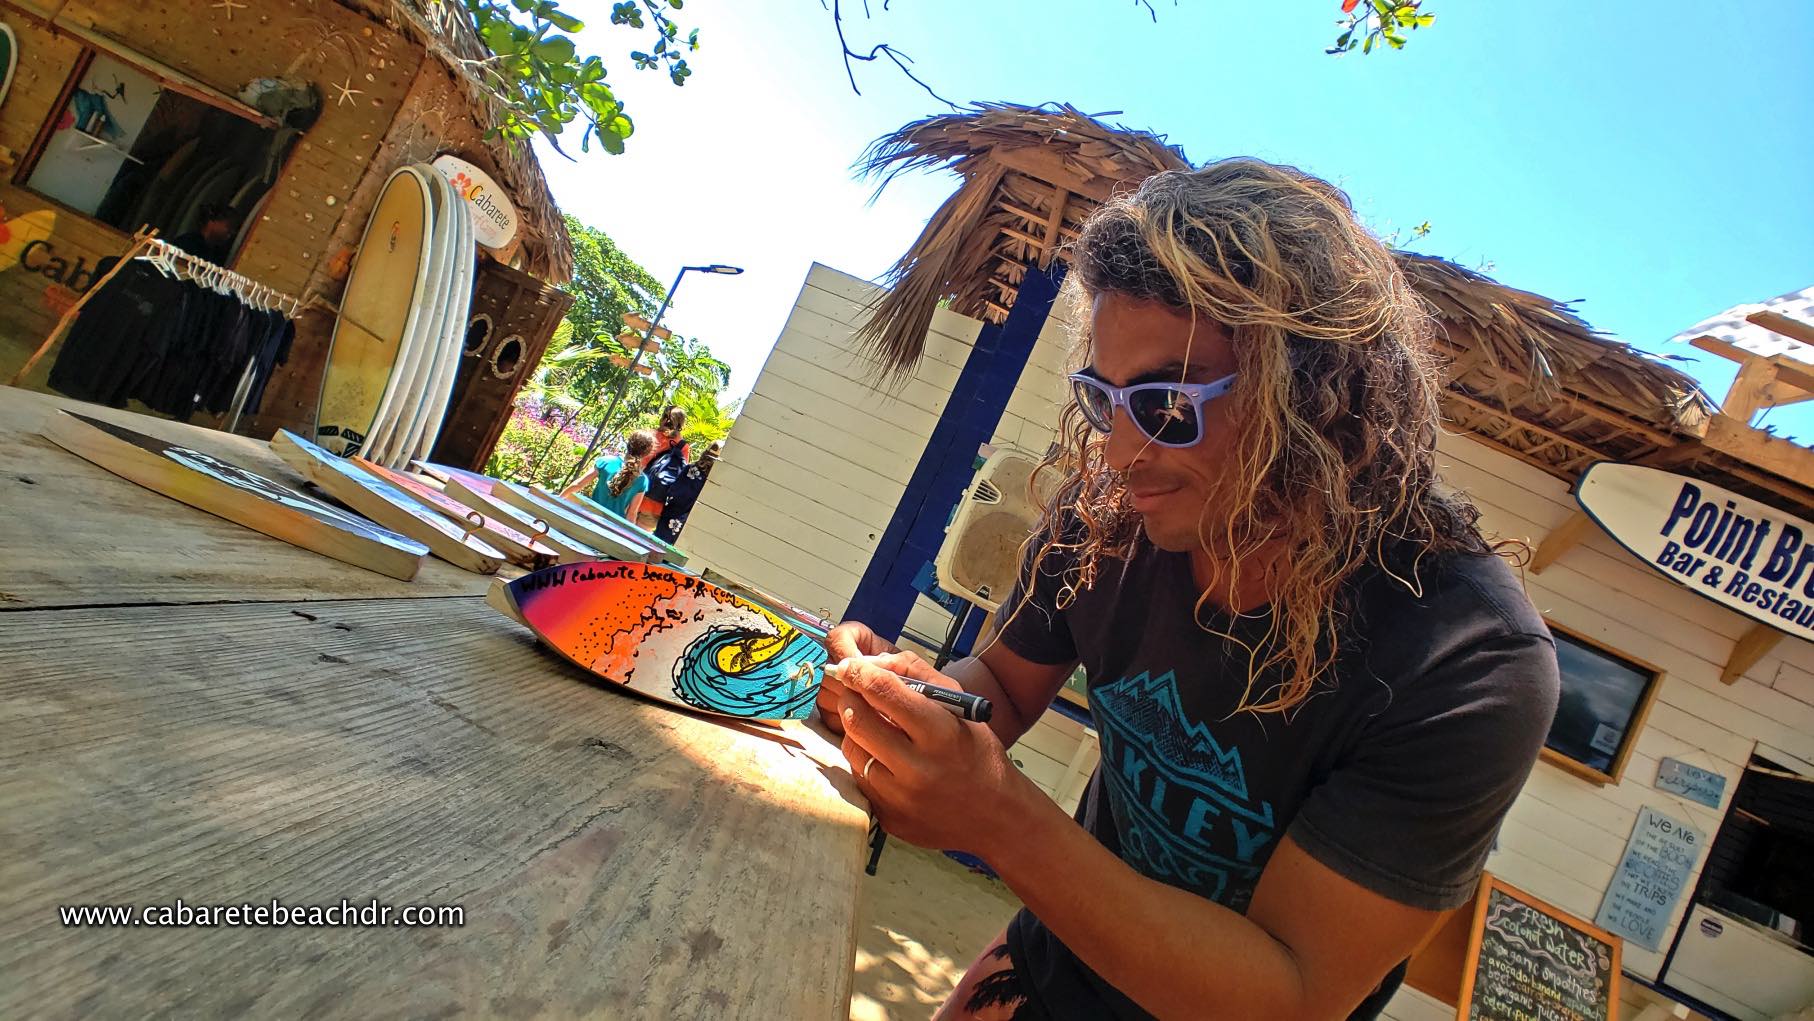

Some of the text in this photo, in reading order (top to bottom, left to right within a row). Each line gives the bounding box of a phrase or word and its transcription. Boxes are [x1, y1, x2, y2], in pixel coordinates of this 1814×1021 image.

[470, 185, 510, 230] Cabarete
[1660, 482, 1771, 571] Point
[1656, 541, 1814, 630] Bar & Restau
[1649, 813, 1672, 834] We
[1634, 882, 1667, 906] TRIPS
[1621, 916, 1656, 940] LOVE
